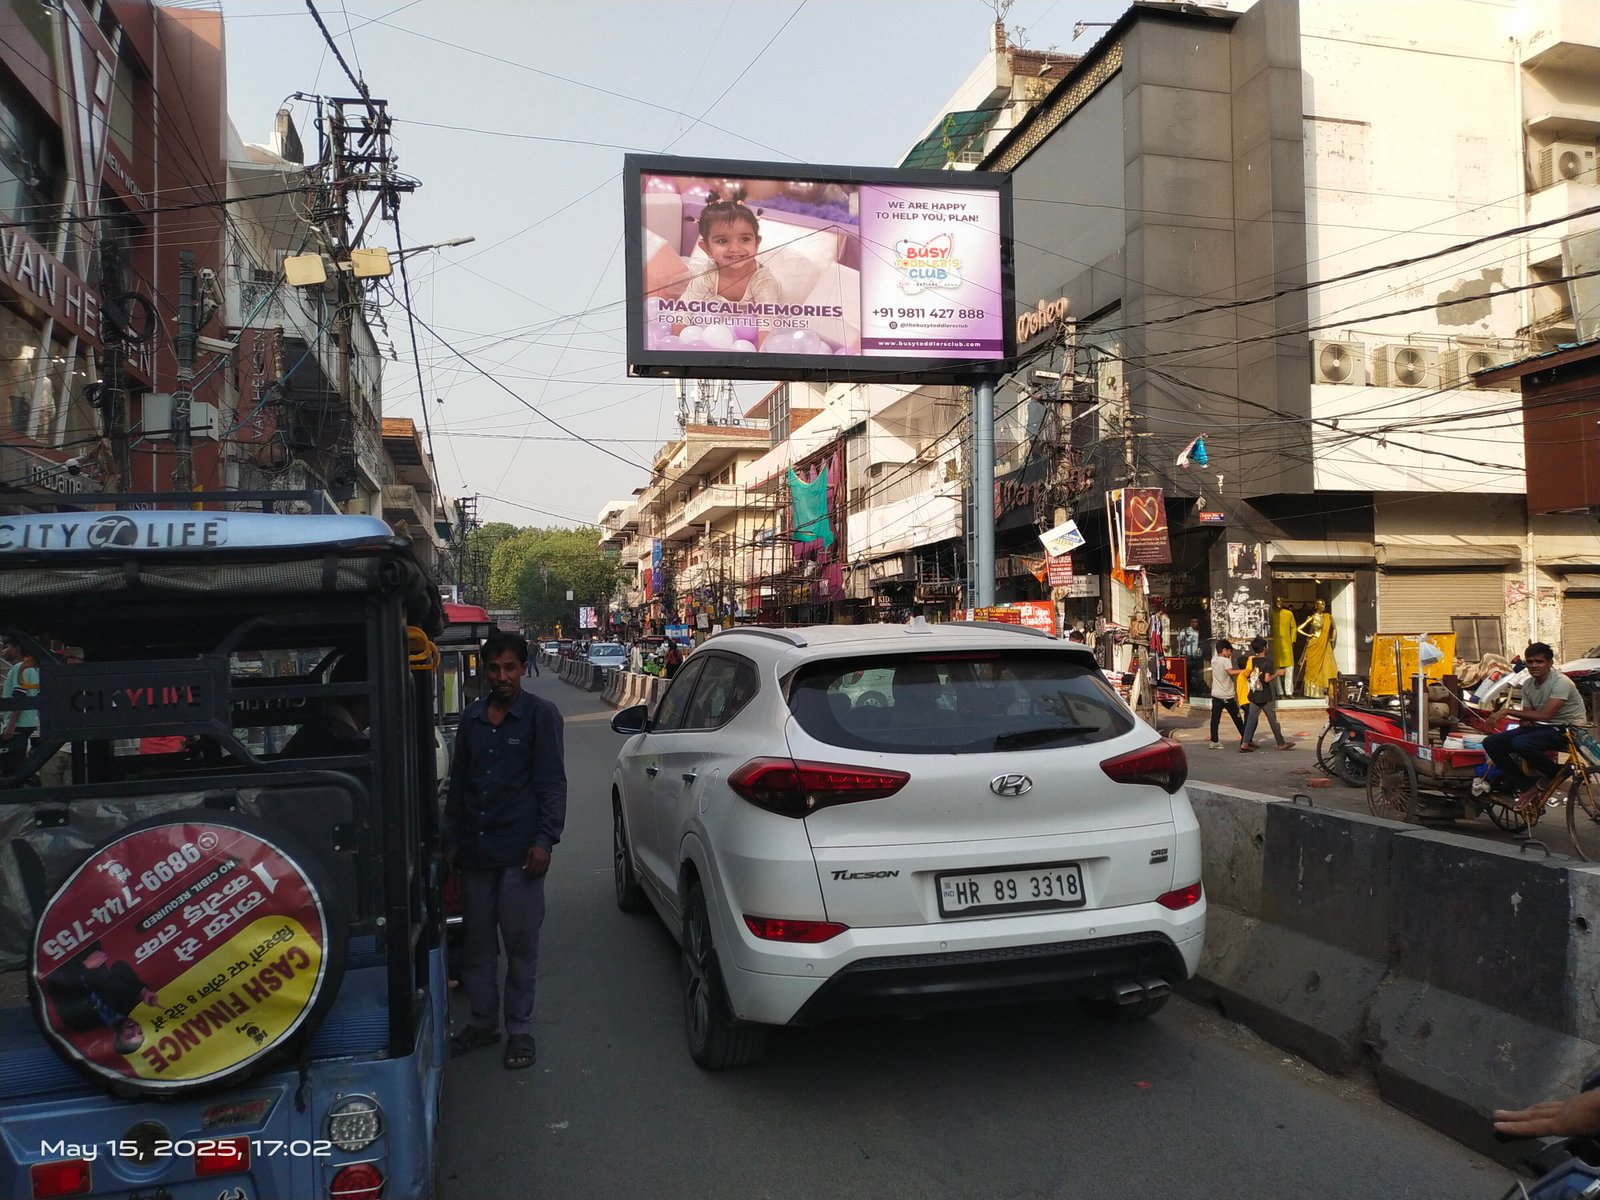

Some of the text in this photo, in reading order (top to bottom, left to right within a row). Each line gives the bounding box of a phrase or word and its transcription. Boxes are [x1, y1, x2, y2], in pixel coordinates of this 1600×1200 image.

[888, 201, 967, 211] WE ARE HAPPY
[875, 211, 979, 222] TO HELP YOU, PLAN!
[907, 247, 948, 259] BUSY
[895, 259, 961, 268] TODDLER'S
[909, 268, 948, 280] CLUB
[0, 221, 151, 378] VAN HEEN
[658, 299, 843, 318] MAGICAL MEMORIES
[658, 314, 809, 329] FOR YOUR LITTLES ONES!
[872, 307, 985, 319] +91 9811 427 888
[878, 340, 981, 348] www.busytoddlersclub.com
[0, 523, 80, 549] CITY
[147, 522, 219, 547] LIFE
[142, 860, 236, 929] NO CIBIL REQUIRED
[956, 874, 1077, 904] HR 89 3318
[43, 842, 201, 960] 9899-744-755
[174, 862, 279, 961] 1 लाख से
[134, 924, 182, 965] तक
[227, 960, 250, 977] पर
[197, 973, 229, 999] लोन
[142, 946, 311, 1073] CASH FINANCE
[150, 1015, 168, 1033] में
